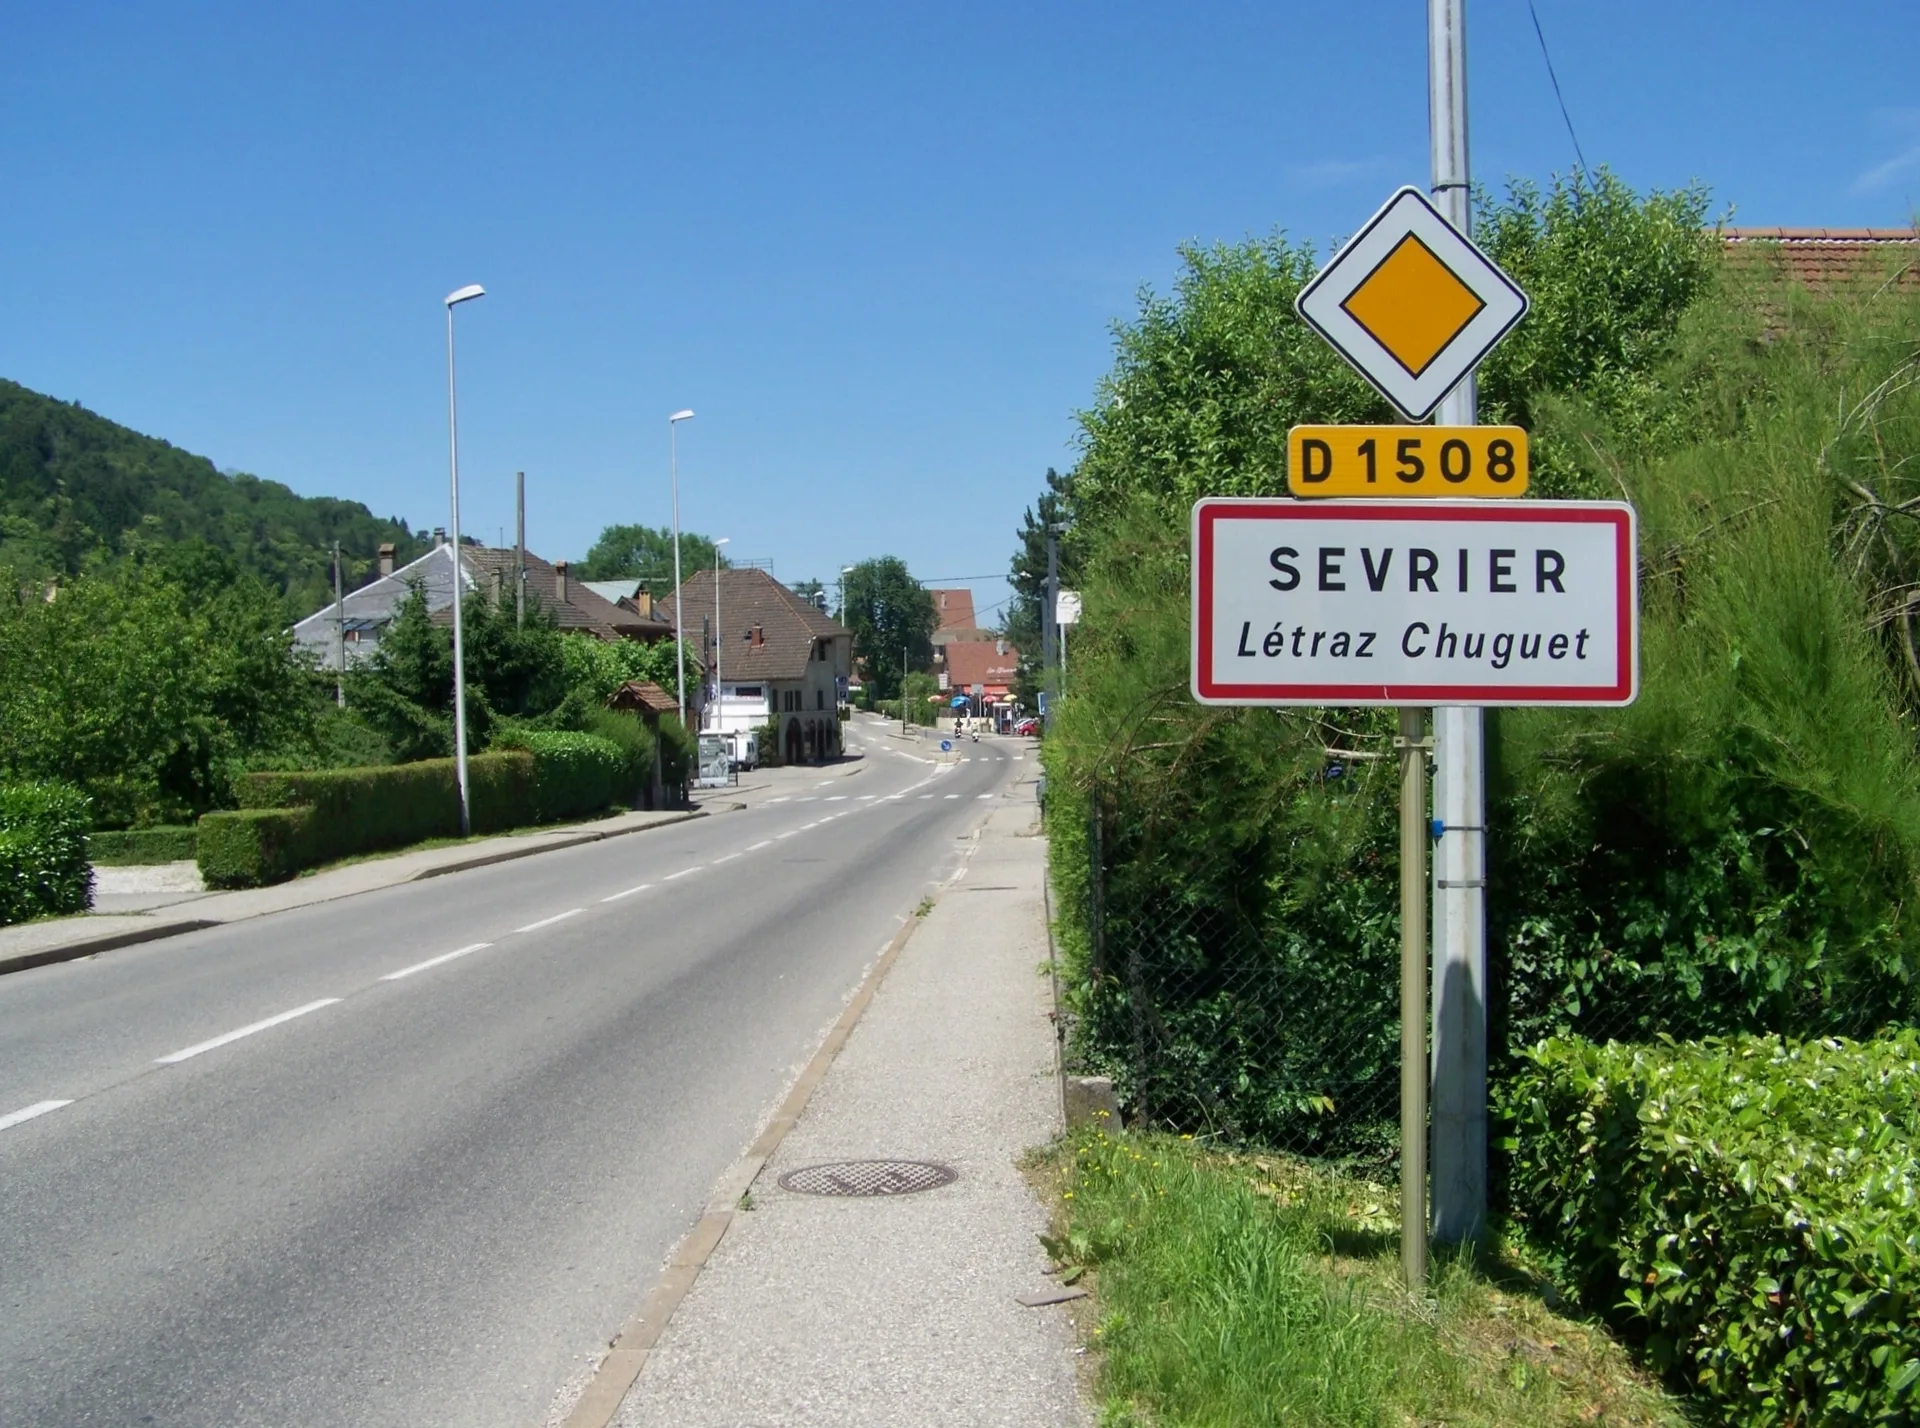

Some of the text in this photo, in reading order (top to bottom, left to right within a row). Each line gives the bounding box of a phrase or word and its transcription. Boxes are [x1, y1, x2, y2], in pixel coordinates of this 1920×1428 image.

[1302, 438, 1516, 483] D 1508
[1269, 546, 1566, 593] SEVRIER
[1237, 621, 1590, 669] Létraz Chuguet
